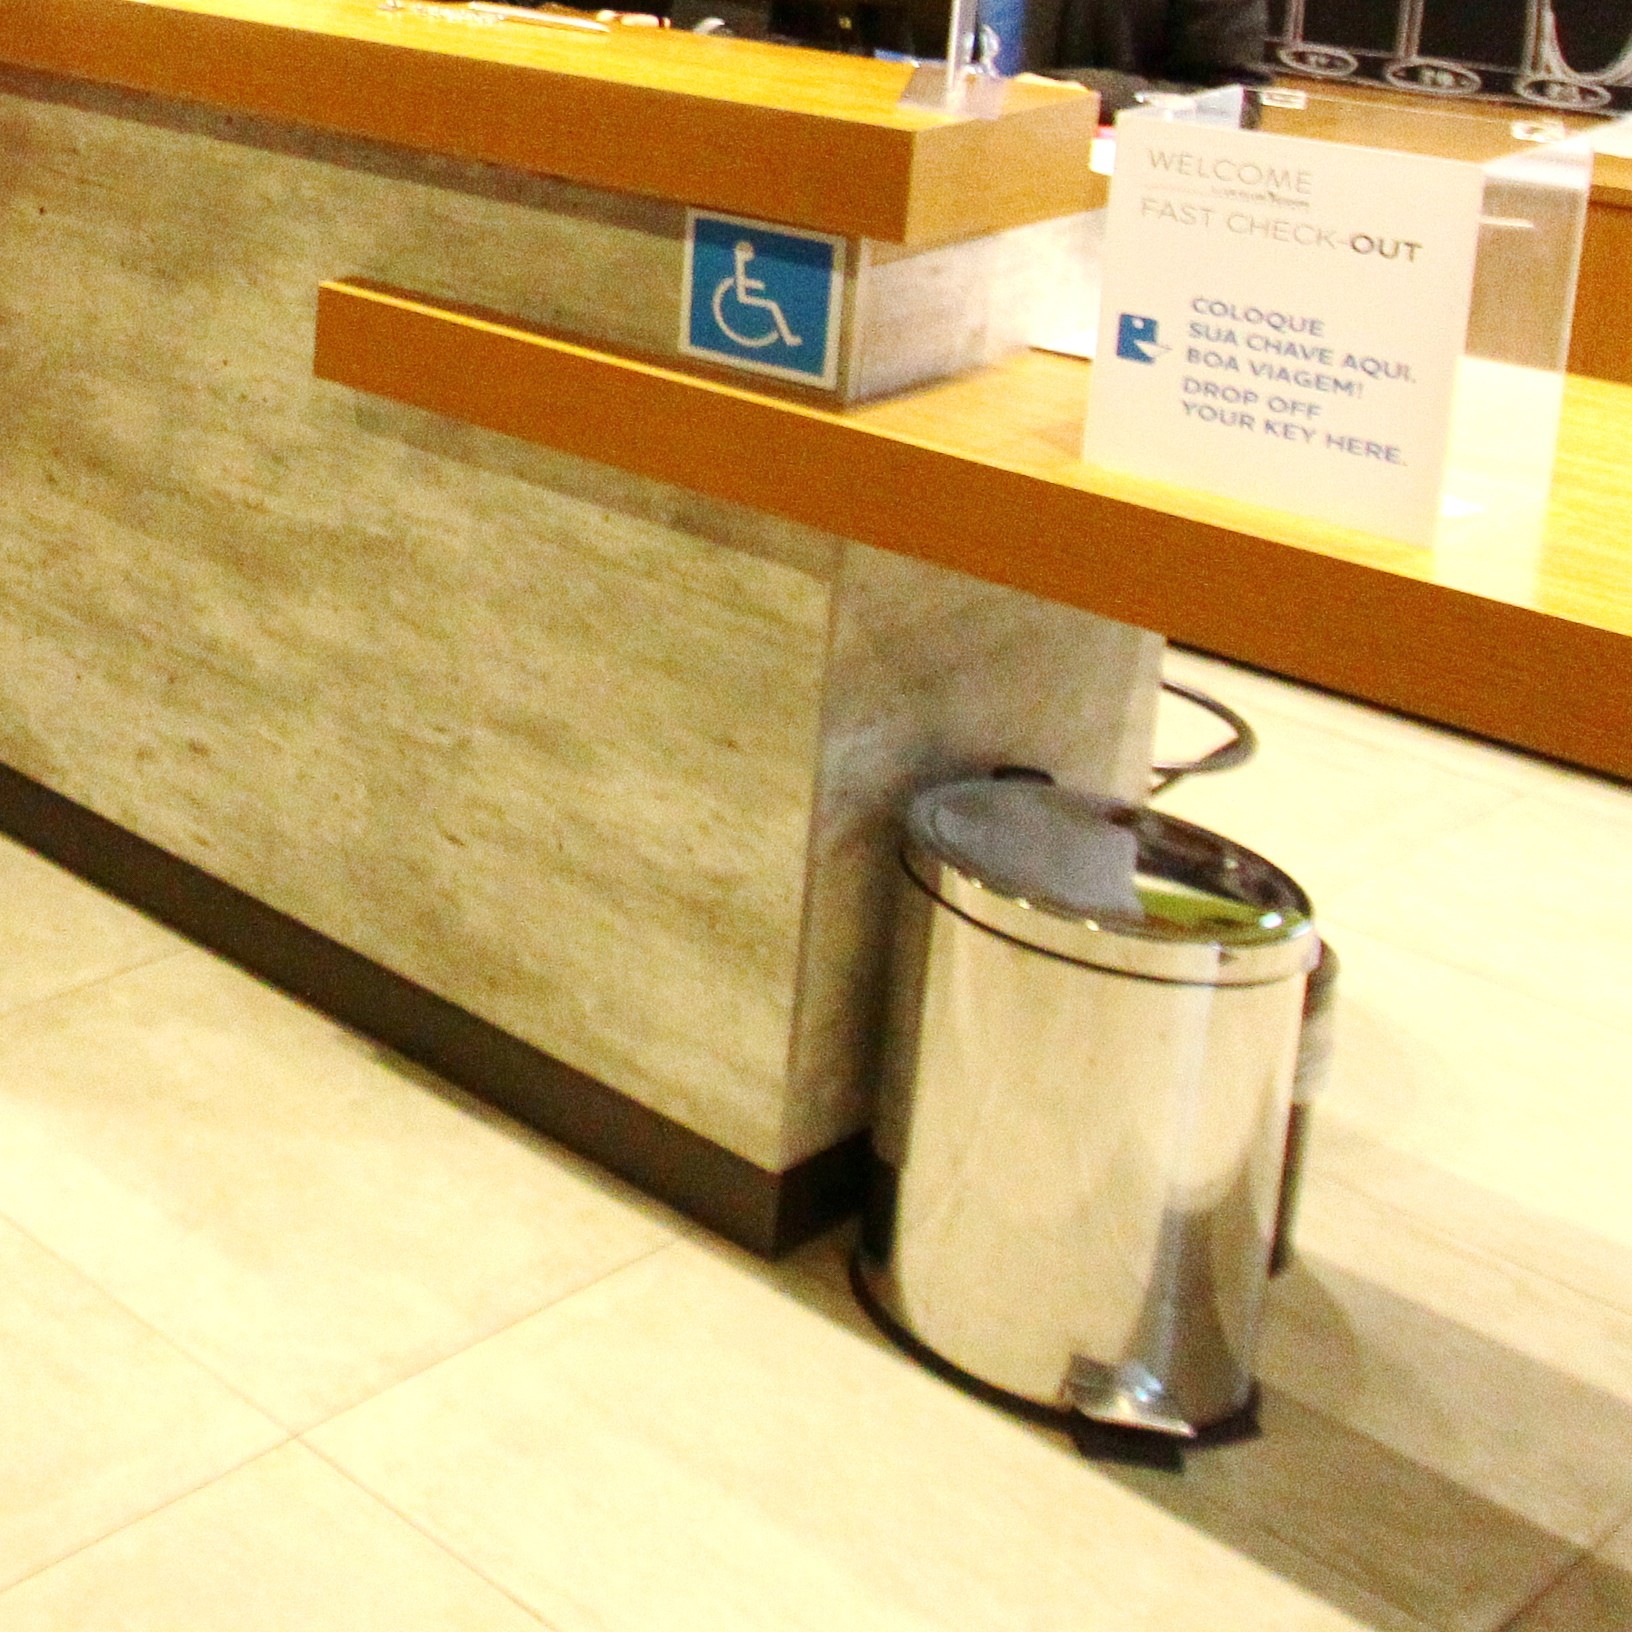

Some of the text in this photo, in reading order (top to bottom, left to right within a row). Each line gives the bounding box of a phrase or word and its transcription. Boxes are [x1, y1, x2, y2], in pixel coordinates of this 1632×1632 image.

[1147, 148, 1313, 196] WELCOME
[1140, 197, 1215, 229] FAST
[1226, 212, 1425, 264] CHECK-OUT
[1191, 297, 1326, 338] COLOQUE
[1188, 321, 1239, 347] SUA
[1246, 333, 1335, 366] CHAVE
[1186, 347, 1365, 400] BOA VIAGEM!
[1182, 376, 1324, 420] DROP OFF
[1180, 400, 1257, 432] YOUR
[1264, 418, 1318, 445] KEY
